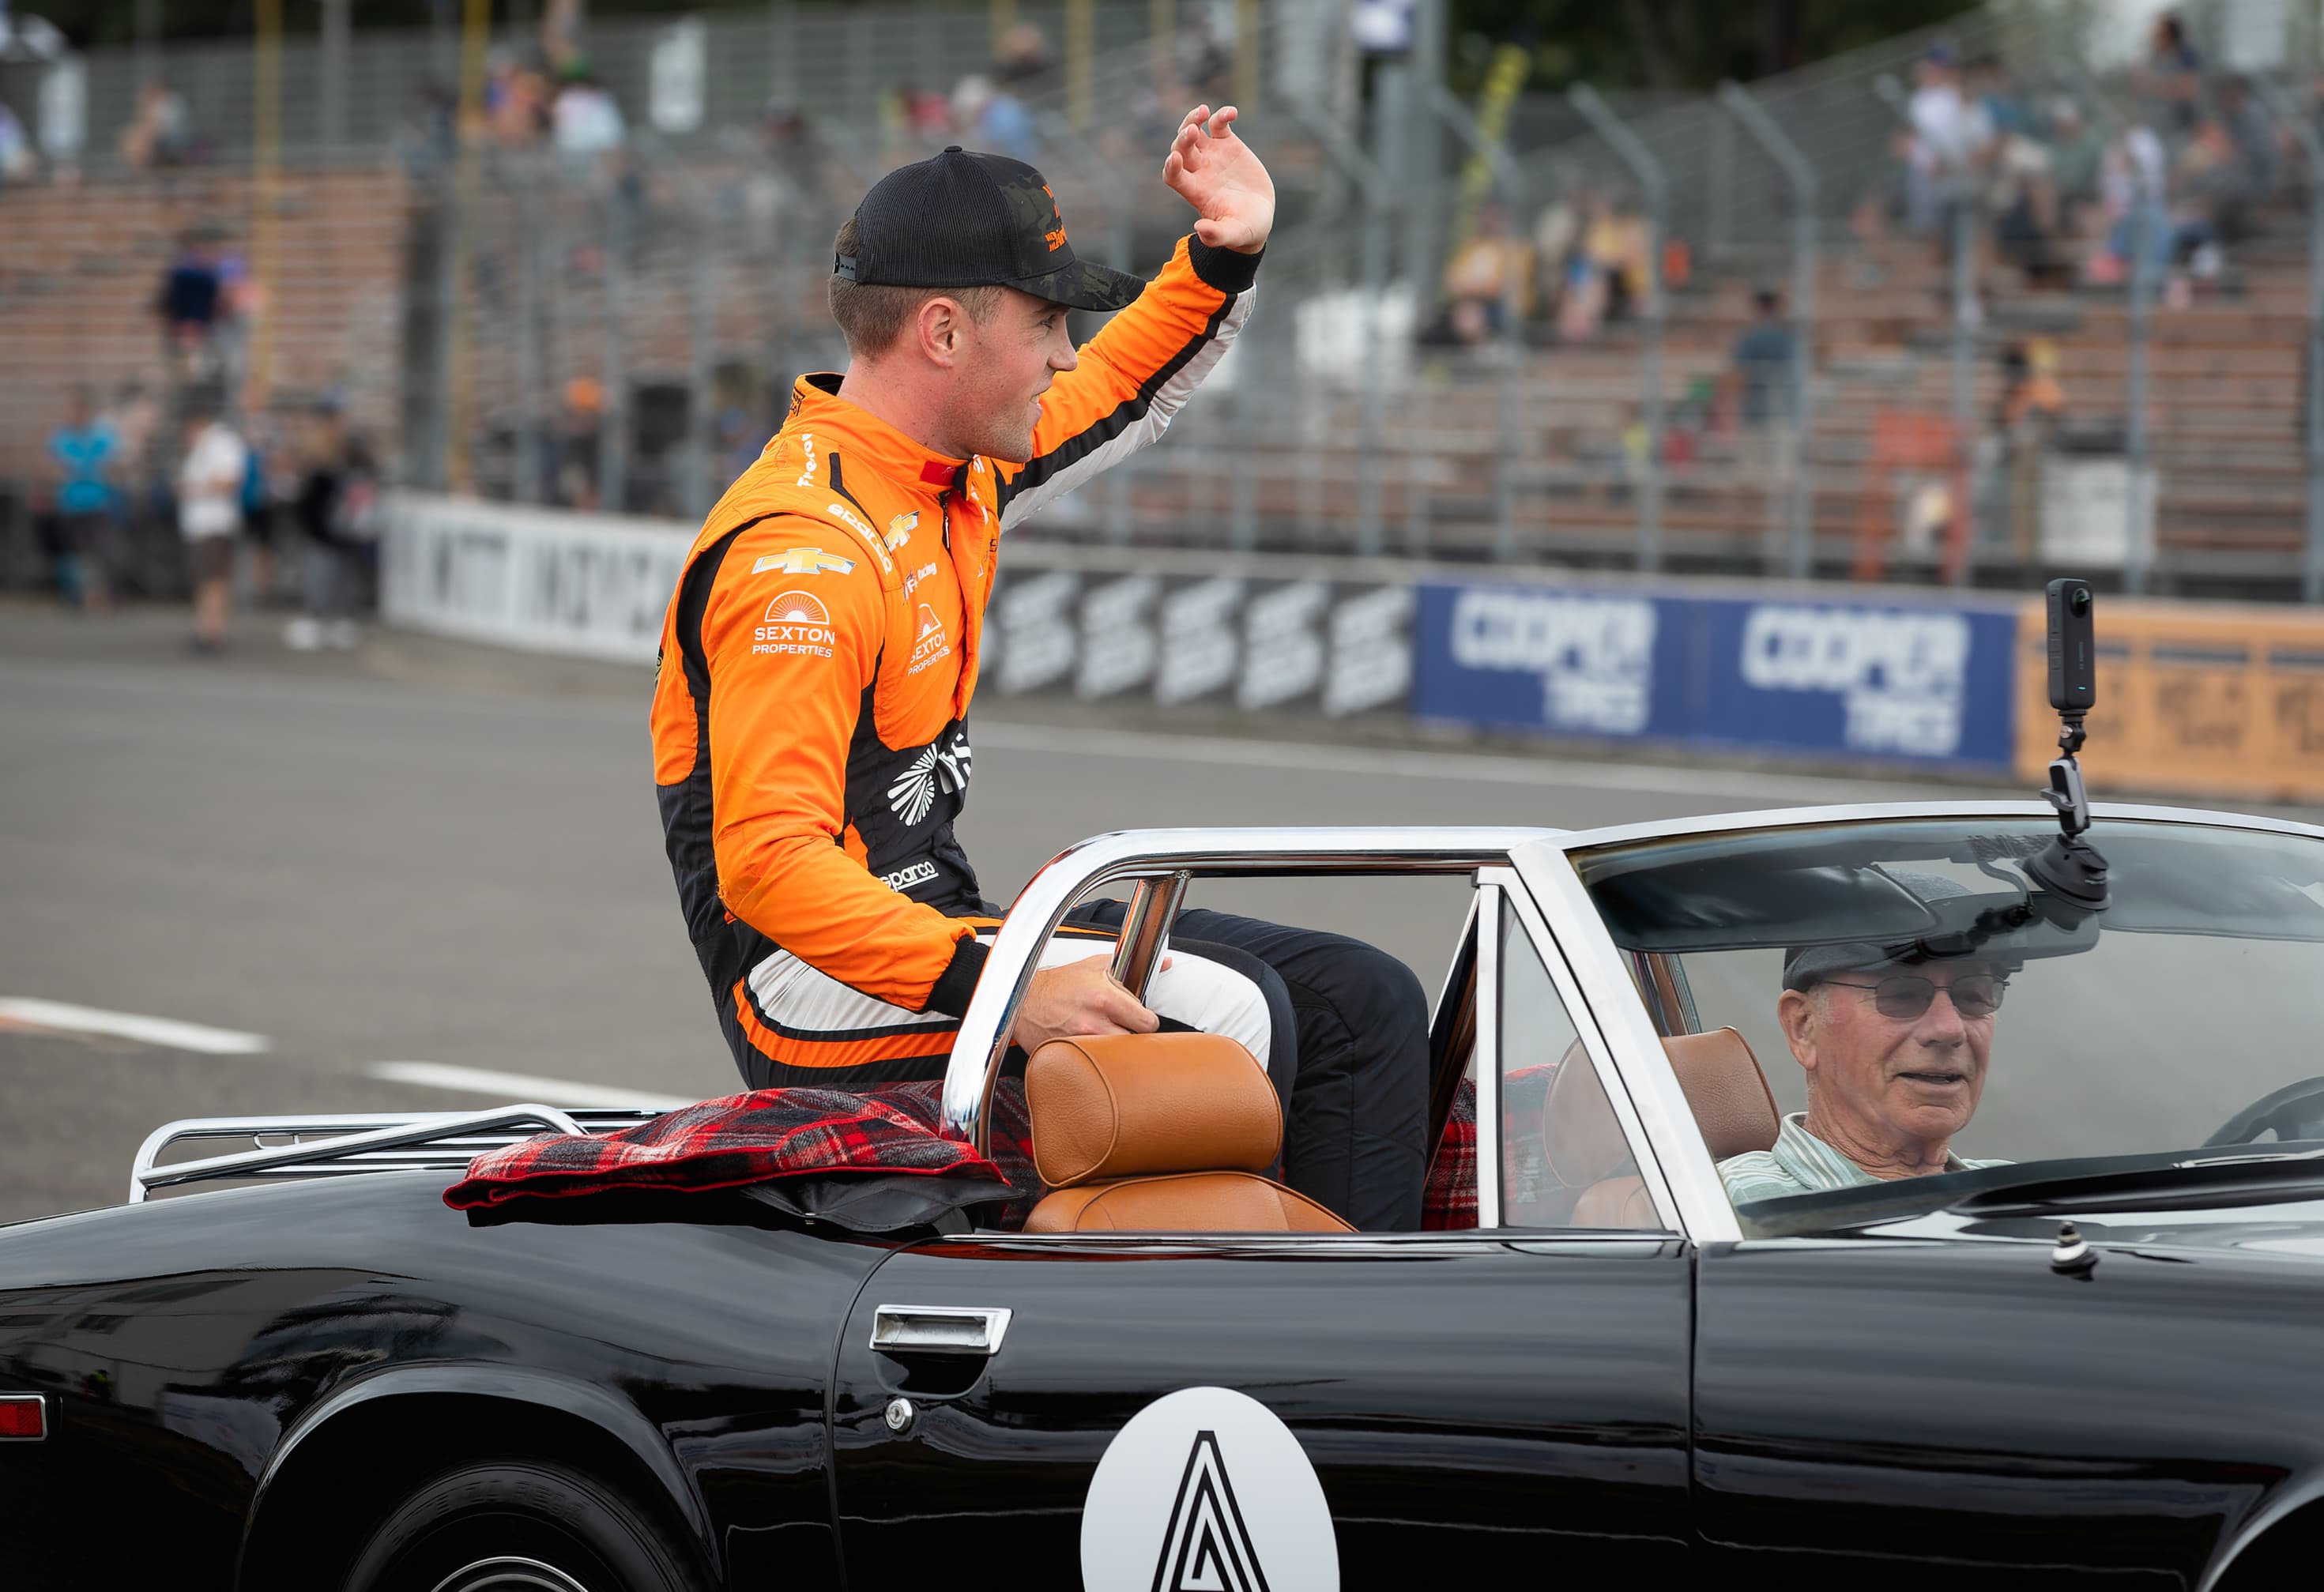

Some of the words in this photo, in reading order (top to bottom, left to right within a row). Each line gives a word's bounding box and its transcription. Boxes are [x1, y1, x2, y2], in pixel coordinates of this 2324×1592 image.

[751, 643, 833, 658] PROPERTIES
[754, 626, 835, 645] SEXTON
[1454, 591, 1656, 683] COOPER
[1742, 606, 1969, 698] COOPER
